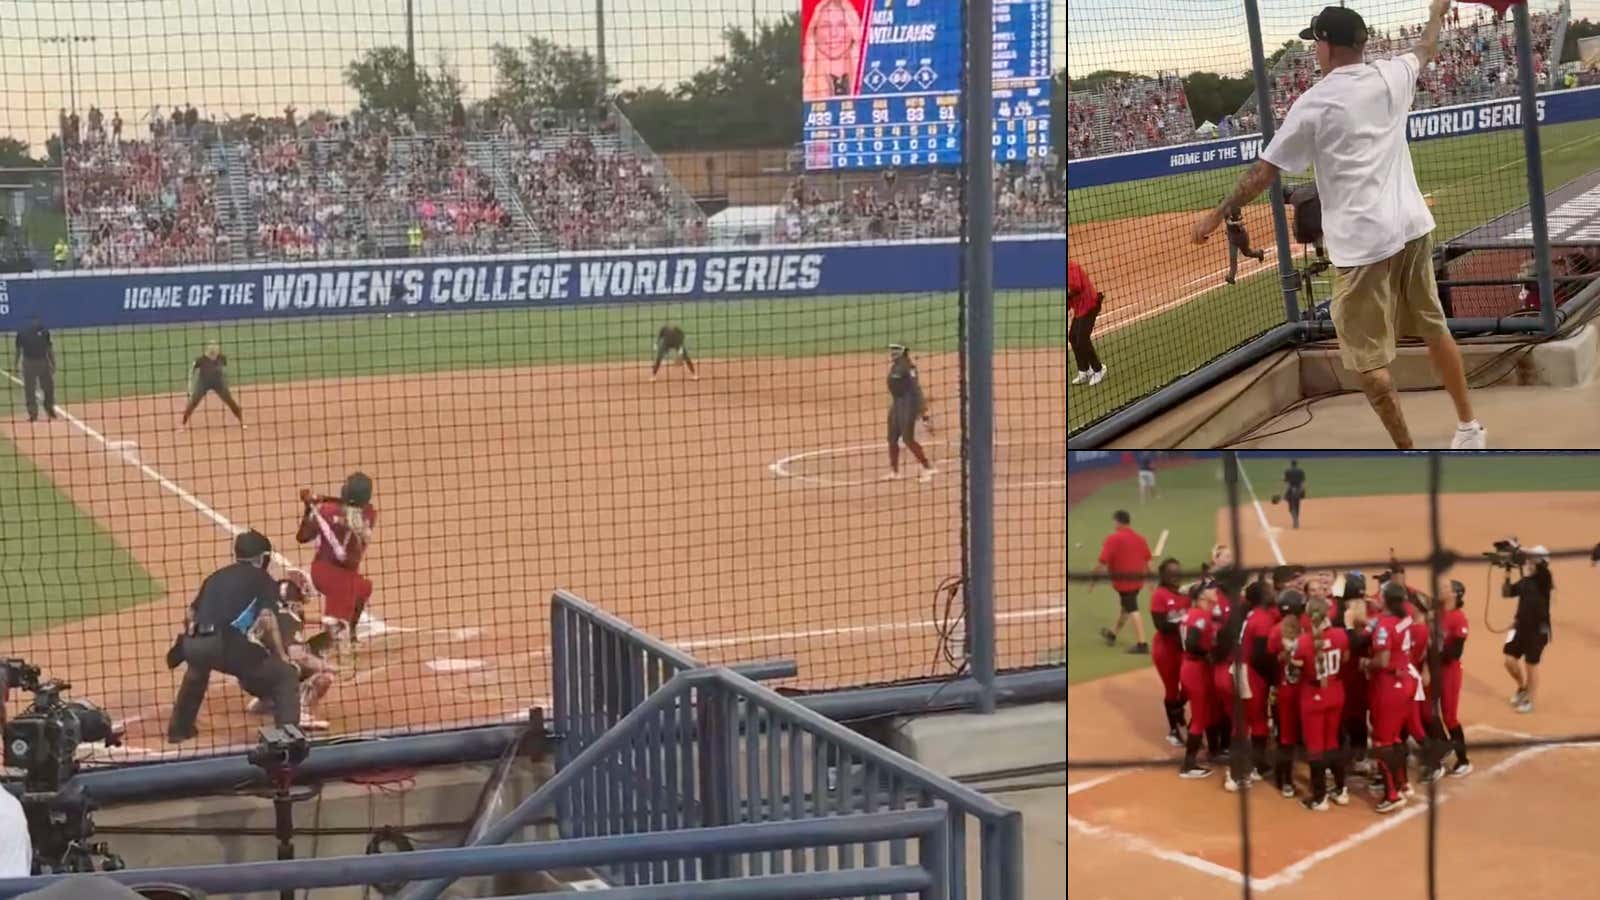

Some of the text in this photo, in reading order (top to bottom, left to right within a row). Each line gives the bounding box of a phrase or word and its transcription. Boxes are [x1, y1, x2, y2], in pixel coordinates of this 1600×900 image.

[868, 24, 936, 44] WILLIAMS
[804, 111, 832, 127] .433
[839, 111, 856, 124] 25
[872, 109, 889, 123] 94
[906, 107, 925, 121] 83
[1039, 120, 1048, 130] 2
[1410, 100, 1546, 138] WORLD SERIS
[947, 124, 955, 134] 7
[1039, 133, 1046, 143] 1
[838, 142, 847, 152] 0
[857, 142, 864, 151] 1
[874, 141, 883, 150] 0
[893, 140, 900, 150] 1
[910, 139, 918, 149] 0
[928, 138, 937, 148] 0
[946, 138, 956, 148] 2
[1006, 134, 1016, 146] 0
[1038, 145, 1048, 156] 0
[838, 148, 1016, 166] 0 1 1 0 2 0 0
[1170, 152, 1201, 167] HOME
[1203, 150, 1216, 162] OF
[1217, 146, 1238, 160] THE
[123, 254, 825, 311] HOME OF THE WOMEN'S COLLEGE WORLD SERIES
